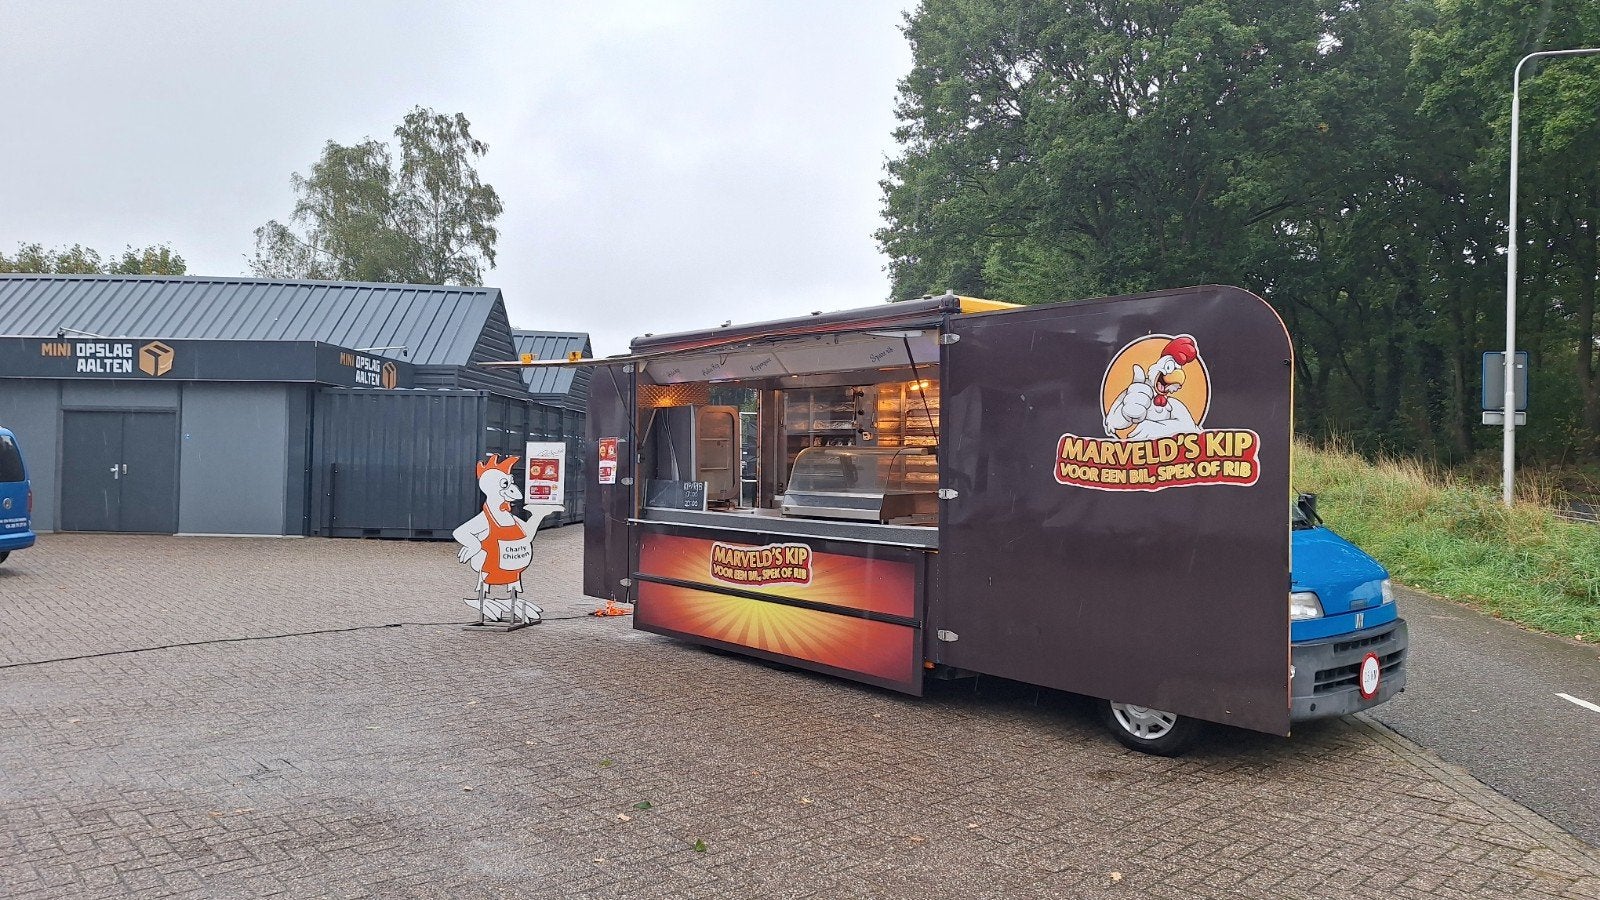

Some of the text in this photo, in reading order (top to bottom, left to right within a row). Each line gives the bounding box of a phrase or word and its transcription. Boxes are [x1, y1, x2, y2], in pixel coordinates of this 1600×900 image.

[41, 342, 133, 358] MINI OPSLAG
[76, 358, 133, 373] AALTEN
[340, 352, 381, 373] MINI OPSLAG
[355, 369, 380, 387] AALTEN
[1061, 431, 1254, 466] MARVELD'S KIP
[1059, 460, 1252, 484] VOOR EEN BIL, SPEK OF RIB
[502, 551, 530, 560] Chicken
[505, 545, 527, 553] Charly
[714, 546, 808, 568] MARVELD'S KIP
[713, 564, 733, 579] VOOR
[733, 569, 748, 581] EEN
[761, 568, 781, 580] SPEK
[781, 567, 793, 578] OF
[793, 567, 807, 580] RIB
